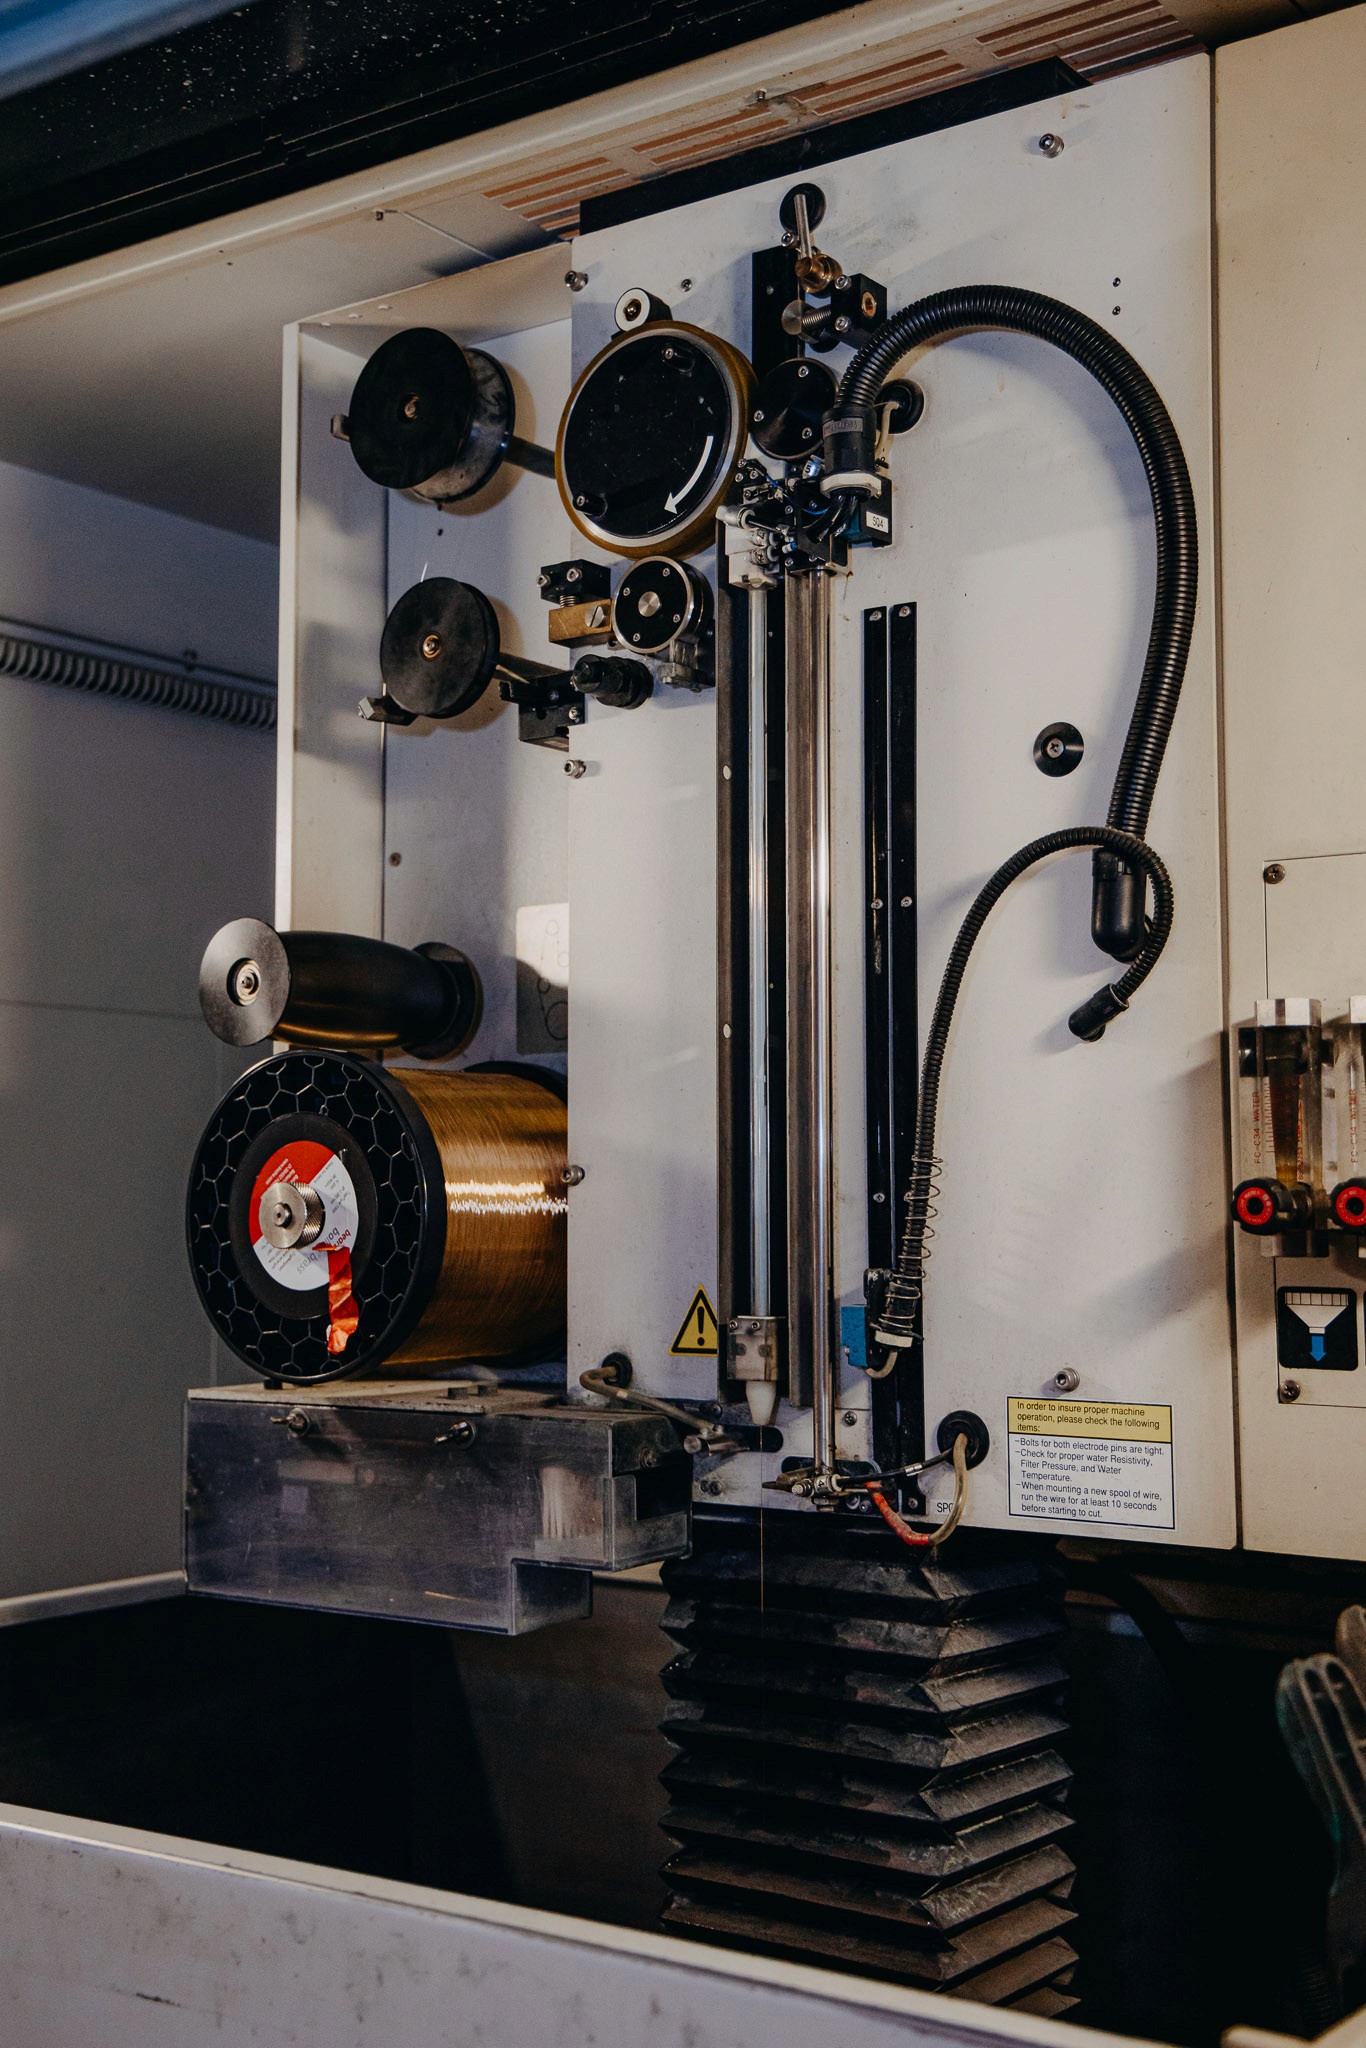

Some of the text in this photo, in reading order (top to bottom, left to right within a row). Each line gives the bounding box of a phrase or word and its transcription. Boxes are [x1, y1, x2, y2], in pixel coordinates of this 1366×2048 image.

[872, 515, 884, 529] SQ4
[1251, 1090, 1260, 1123] WATER
[297, 1251, 319, 1275] brass
[1018, 1402, 1024, 1410] In
[1026, 1403, 1046, 1411] order
[1058, 1405, 1081, 1413] insure
[1084, 1406, 1108, 1415] proper
[1111, 1407, 1145, 1416] machine
[1017, 1414, 1160, 1430] operation, please check the following
[1017, 1423, 1040, 1432] items:
[1041, 1439, 1051, 1447] for
[1053, 1440, 1070, 1448] both
[1072, 1442, 1108, 1451] electrode
[1111, 1443, 1127, 1453] pins
[1144, 1446, 1164, 1455] tight.
[1047, 1450, 1057, 1459] for
[1059, 1452, 1084, 1461] proper
[1086, 1453, 1108, 1462] water
[1111, 1455, 1153, 1466] Resistivity,
[1021, 1460, 1121, 1474] Filter Pressure, and Water
[1021, 1471, 1072, 1482] Temperature.
[1046, 1484, 1081, 1495] mounting
[1110, 1488, 1130, 1498] spool
[1133, 1489, 1140, 1498] of
[1142, 1490, 1162, 1500] wire,
[1036, 1494, 1048, 1502] the
[1050, 1495, 1066, 1503] wire
[1068, 1496, 1078, 1504] for
[1090, 1498, 1109, 1507] least
[1112, 1499, 1121, 1508] 10
[1124, 1501, 1157, 1511] seconds
[1022, 1504, 1102, 1518] before starting to cut.
